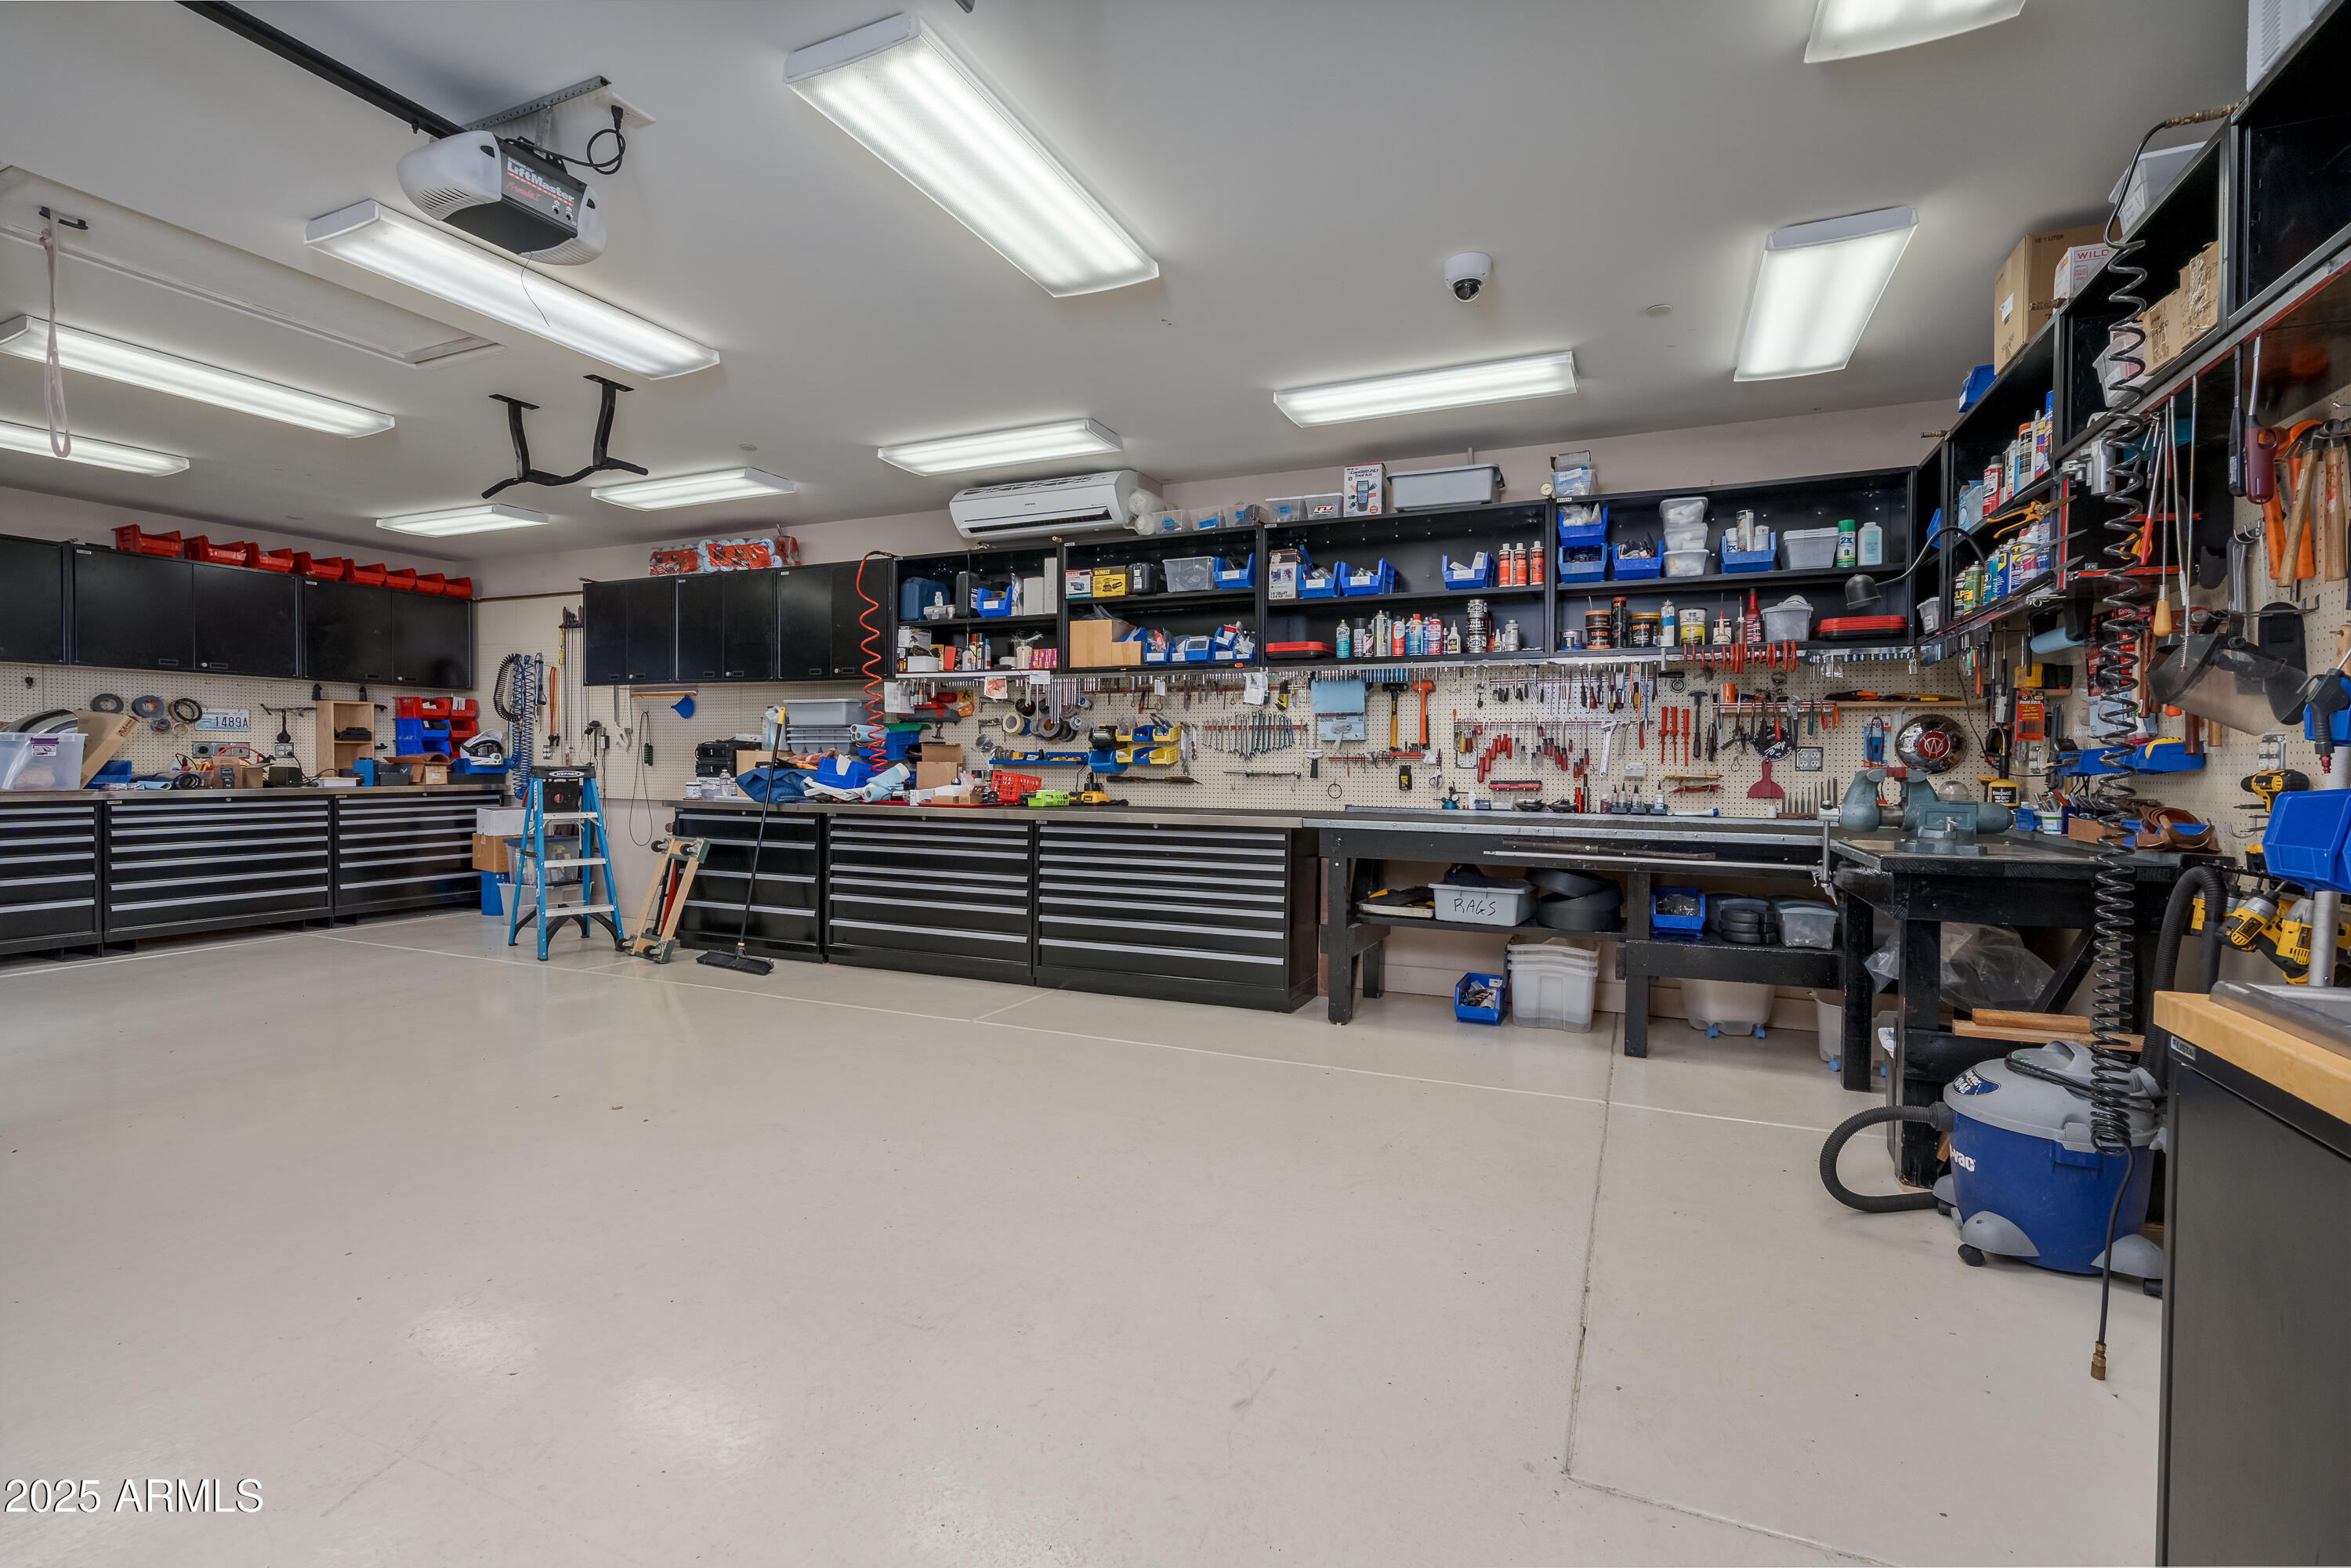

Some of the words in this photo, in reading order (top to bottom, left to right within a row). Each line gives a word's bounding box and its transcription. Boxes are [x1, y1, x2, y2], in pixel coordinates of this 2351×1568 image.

[507, 161, 574, 203] LiftMaster
[216, 716, 248, 728] 1489A
[1454, 898, 1496, 916] RAGS
